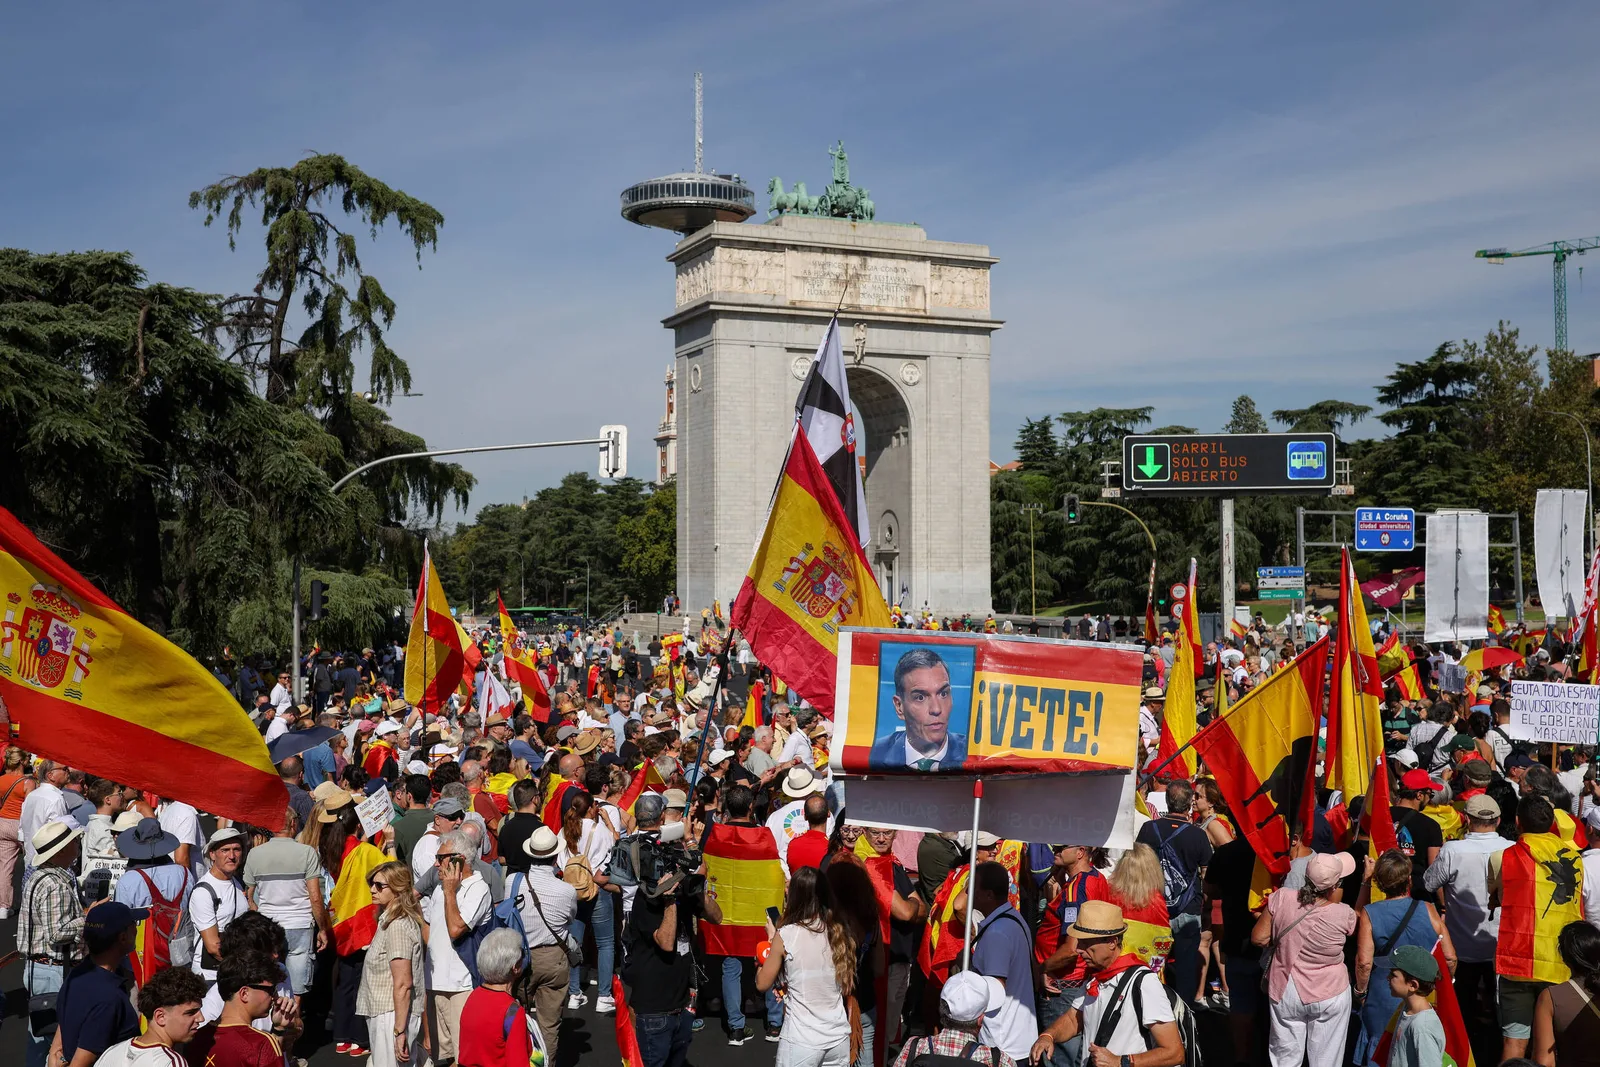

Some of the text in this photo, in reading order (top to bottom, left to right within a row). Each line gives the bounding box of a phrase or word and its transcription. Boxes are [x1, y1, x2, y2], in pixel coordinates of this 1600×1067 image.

[1172, 442, 1227, 454] CARRIL
[1172, 455, 1248, 467] SOLO BUS
[1172, 470, 1238, 482] ABIERTO
[1376, 512, 1381, 520] A
[1385, 512, 1408, 521] Coruña
[1542, 683, 1566, 698] TODA
[1510, 698, 1527, 711] CON
[1572, 701, 1600, 716] MENOS
[973, 679, 1104, 757] ¡VETE!
[1522, 713, 1598, 730] EL GOBIERNO
[1534, 726, 1598, 745] MARCIANO
